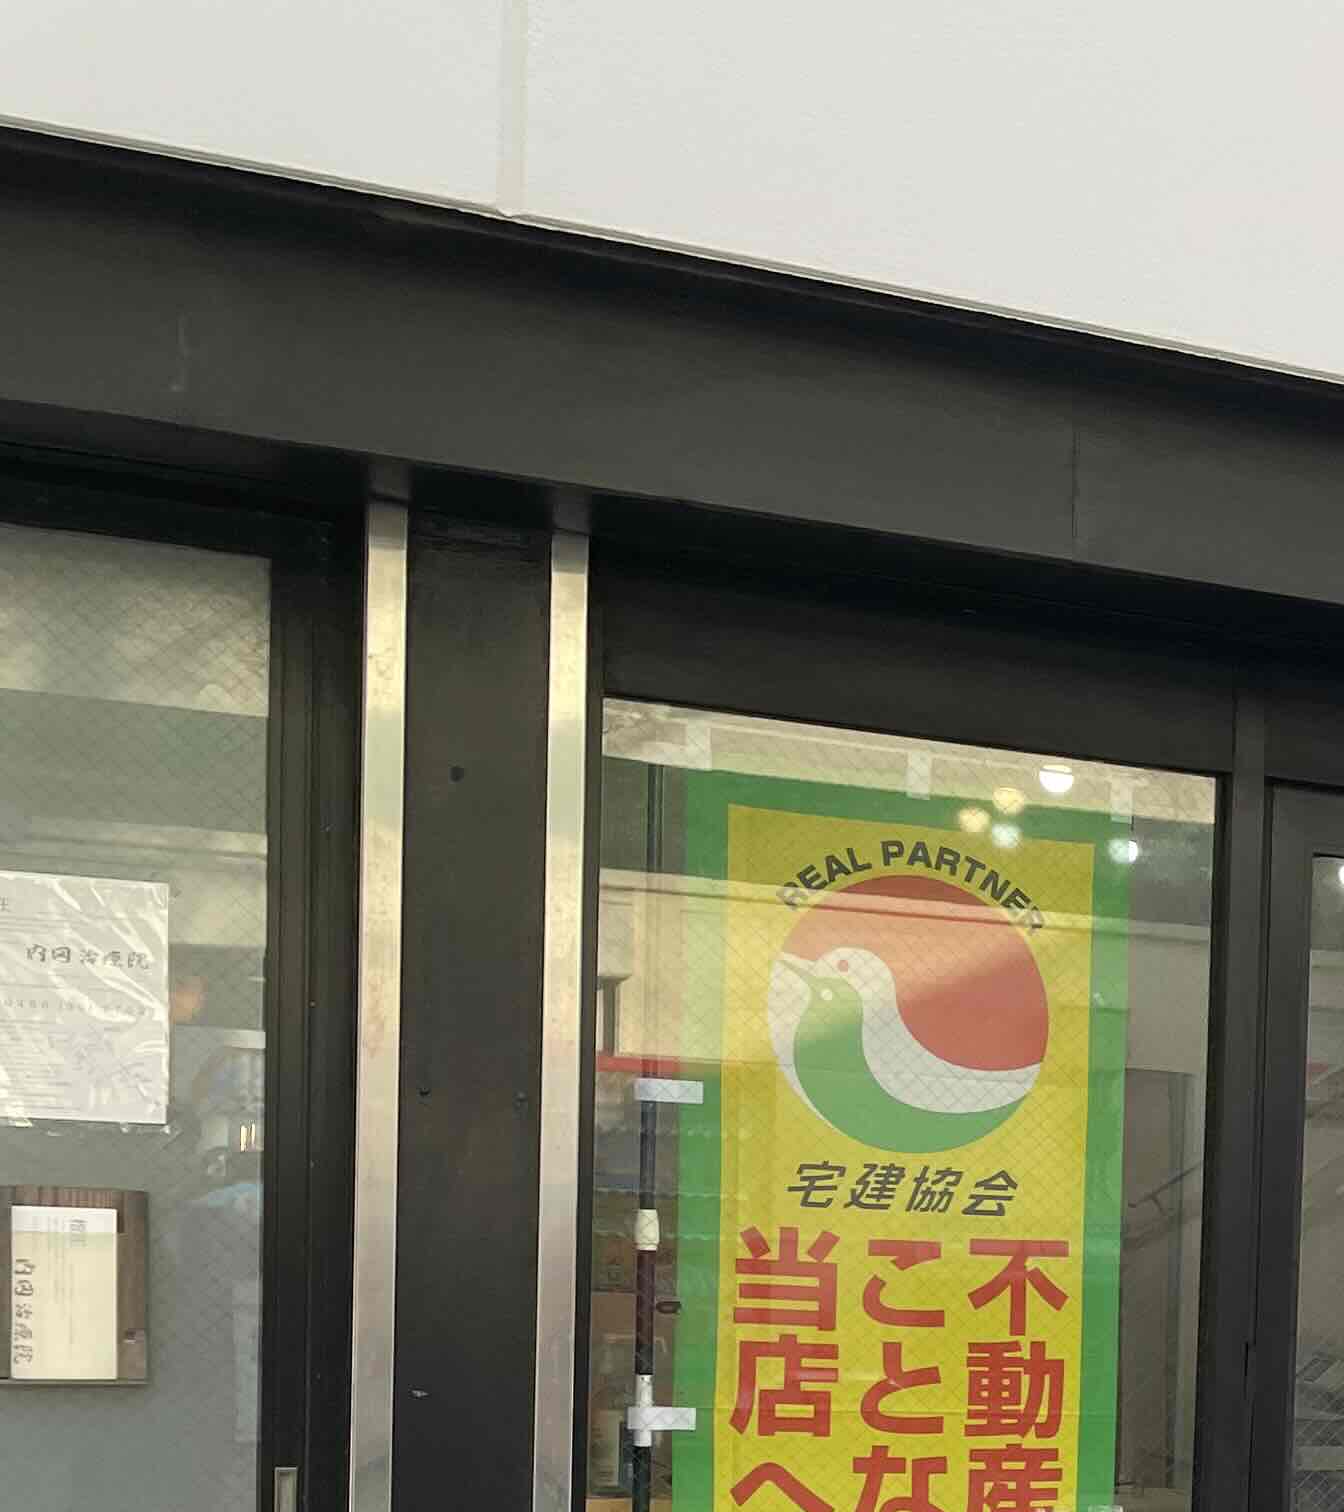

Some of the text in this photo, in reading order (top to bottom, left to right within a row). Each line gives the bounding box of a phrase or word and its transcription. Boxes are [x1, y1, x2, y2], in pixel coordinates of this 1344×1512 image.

[775, 840, 1044, 936] REAL PARTNER
[786, 1160, 1019, 1218] 宅建協会
